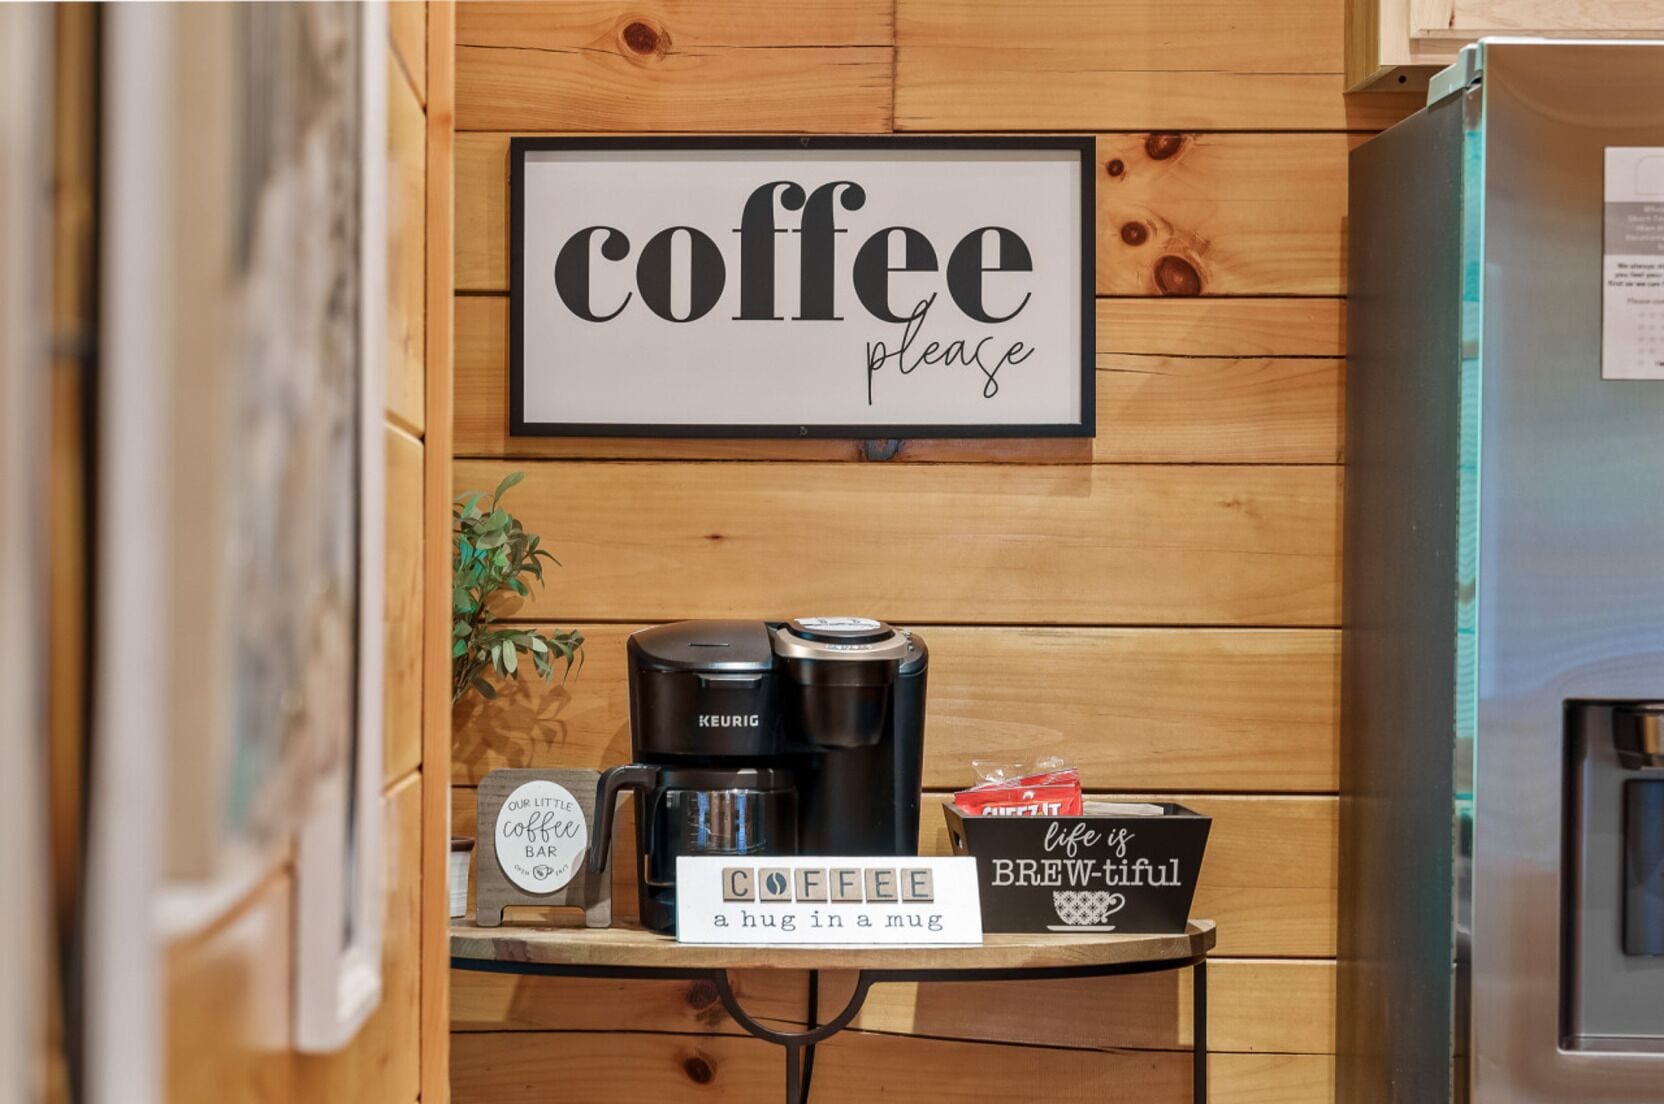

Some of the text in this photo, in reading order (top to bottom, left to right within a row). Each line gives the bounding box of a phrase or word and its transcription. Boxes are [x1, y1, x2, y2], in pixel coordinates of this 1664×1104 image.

[554, 180, 1033, 323] coffee
[866, 298, 1035, 405] please
[699, 715, 759, 727] KEURIG
[508, 797, 574, 812] OUR LITTLE
[503, 811, 580, 843] coffee
[1044, 821, 1135, 858] life is
[525, 845, 558, 858] BAR
[992, 858, 1182, 886] BREW-tiful
[714, 910, 944, 931] a hug in a mug
